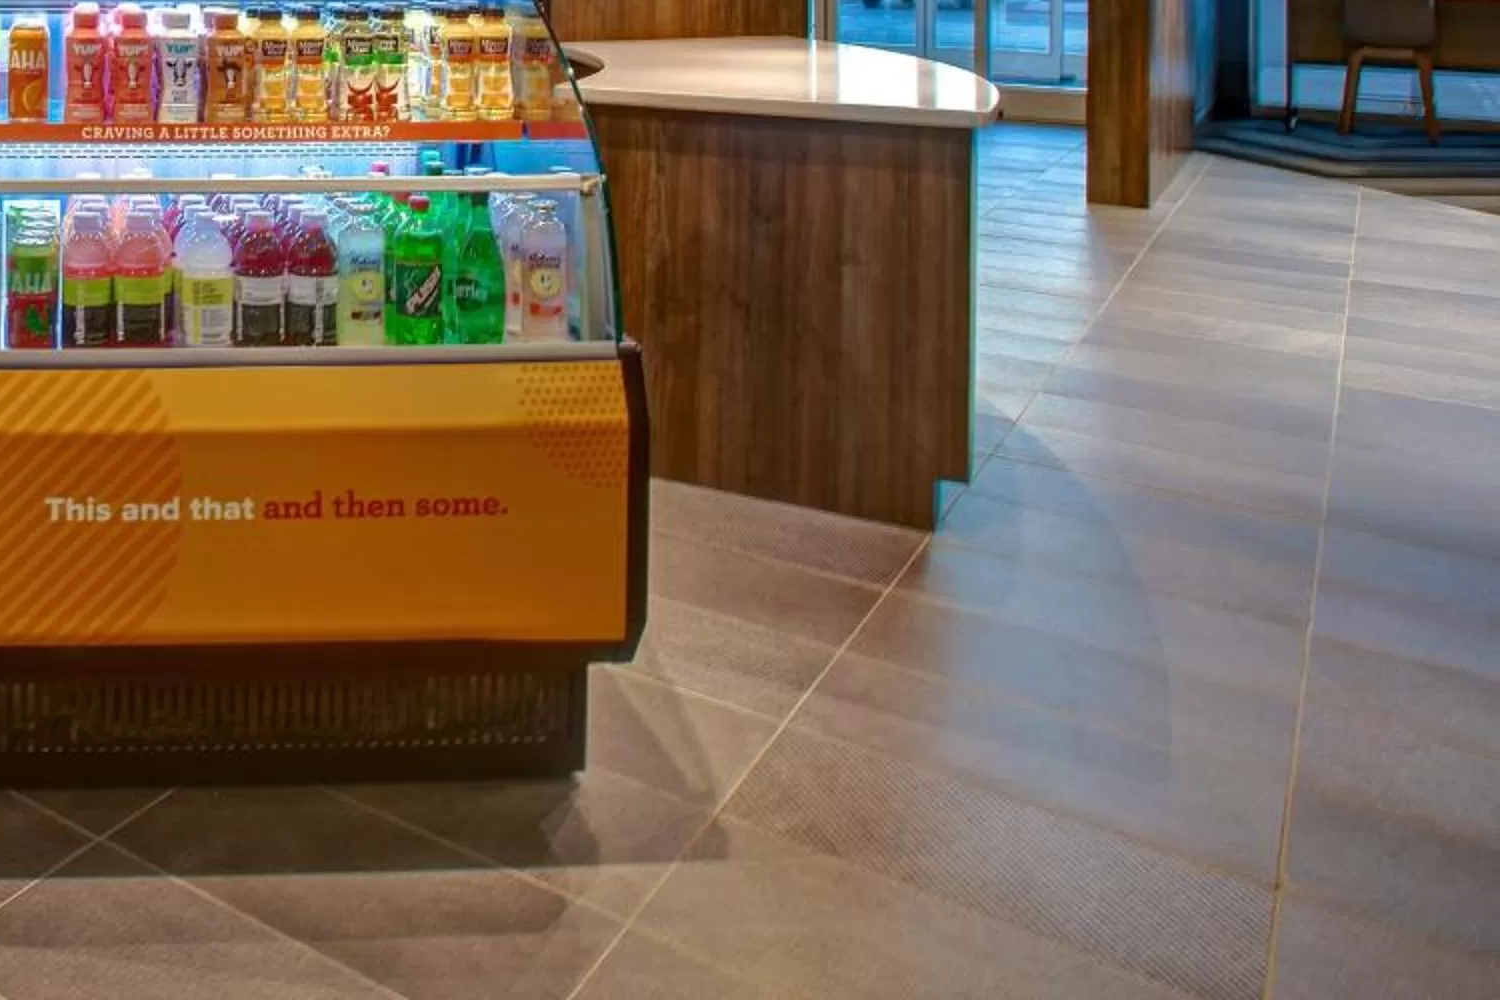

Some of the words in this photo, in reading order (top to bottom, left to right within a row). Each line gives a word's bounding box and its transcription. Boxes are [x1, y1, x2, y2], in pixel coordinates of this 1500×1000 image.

[11, 50, 46, 69] AHA
[81, 127, 155, 140] CRAVING
[159, 127, 171, 140] A
[175, 127, 229, 140] LITTLE
[232, 126, 328, 139] SOMETHING
[331, 125, 392, 139] EXTRA?
[12, 271, 53, 293] AHA
[44, 496, 112, 521] This
[121, 496, 181, 521] and
[189, 496, 255, 521] that
[263, 489, 323, 519] and
[333, 488, 406, 518] then
[414, 495, 509, 517] some.
